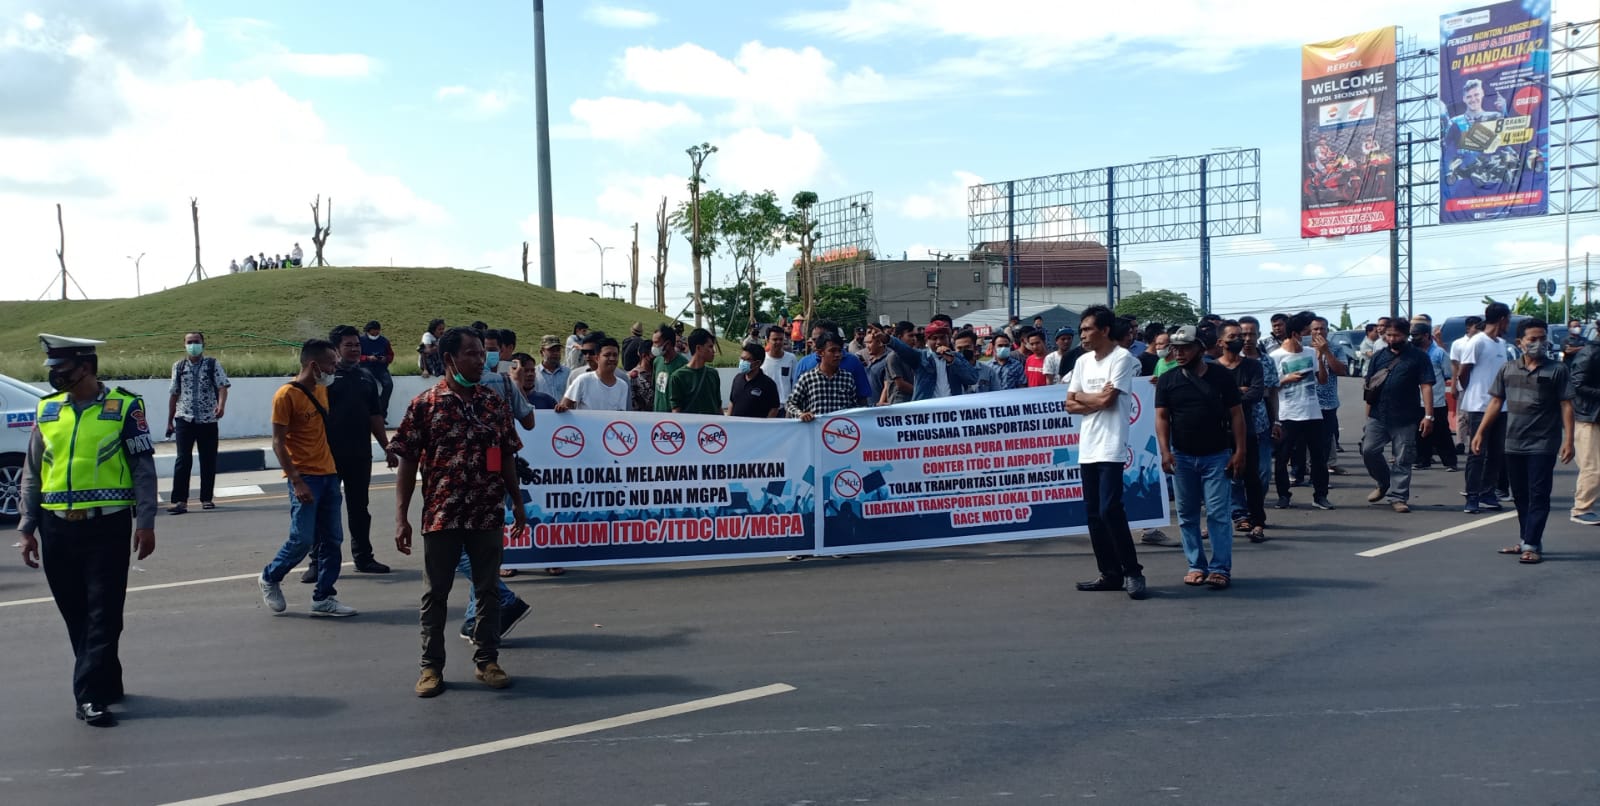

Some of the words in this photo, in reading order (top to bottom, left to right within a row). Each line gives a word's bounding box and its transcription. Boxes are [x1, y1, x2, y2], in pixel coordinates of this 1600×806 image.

[1326, 60, 1363, 72] REPSOL
[1451, 60, 1461, 70] DI
[1463, 39, 1543, 68] MANDALIKA?
[1311, 72, 1384, 95] WELCOME
[1334, 89, 1369, 100] HONDA
[1370, 86, 1388, 94] TEAM
[1495, 119, 1504, 133] 8
[1503, 132, 1511, 144] 4
[1340, 211, 1384, 224] KENCANA
[7, 412, 35, 423] PAT
[877, 414, 903, 428] USIR
[904, 411, 930, 426] STAF
[932, 409, 957, 424] ITDC
[960, 407, 987, 421] YANG
[989, 404, 1020, 419] TELAH
[1022, 400, 1067, 415] MELECEH
[897, 426, 960, 442] PENGUSAHA
[963, 419, 1040, 438] TRANSPORTASI
[1042, 416, 1073, 431] LOKAL
[126, 433, 152, 455] PAT
[863, 447, 920, 462] MENUNTUT
[923, 442, 973, 459] ANGKASA
[975, 440, 1002, 455] PURA
[1005, 433, 1080, 452] MEMBATALKAN
[577, 467, 622, 484] LOKAL
[626, 464, 698, 483] MELAWAN
[702, 461, 785, 481] KIBIJAKKAN
[923, 460, 964, 475] CONTER
[966, 458, 991, 472] ITDC
[994, 457, 1005, 470] DI
[1007, 452, 1052, 469] AIRPORT
[889, 480, 922, 495] TOLAK
[924, 474, 997, 493] TRANPORTASI
[999, 472, 1025, 487] LUAR
[1028, 469, 1065, 485] MASUK
[1067, 467, 1080, 480] NT
[546, 489, 626, 508] ITDC/ITDC
[629, 489, 650, 506] NU
[653, 488, 682, 505] DAN
[686, 487, 728, 504] MGPA
[864, 500, 915, 516] LIBATKAN
[916, 494, 996, 512] TRANSPORTASI
[998, 490, 1029, 506] LOKAL
[1031, 489, 1043, 503] DI
[1045, 486, 1082, 501] PARAM
[953, 511, 980, 526] RACE
[982, 508, 1014, 523] MOTO
[1015, 506, 1031, 521] GP
[503, 525, 531, 548] SIR
[535, 522, 608, 547] OKNUM
[613, 519, 713, 544] ITDC/ITDC
[716, 514, 804, 538] NU/MGPA
